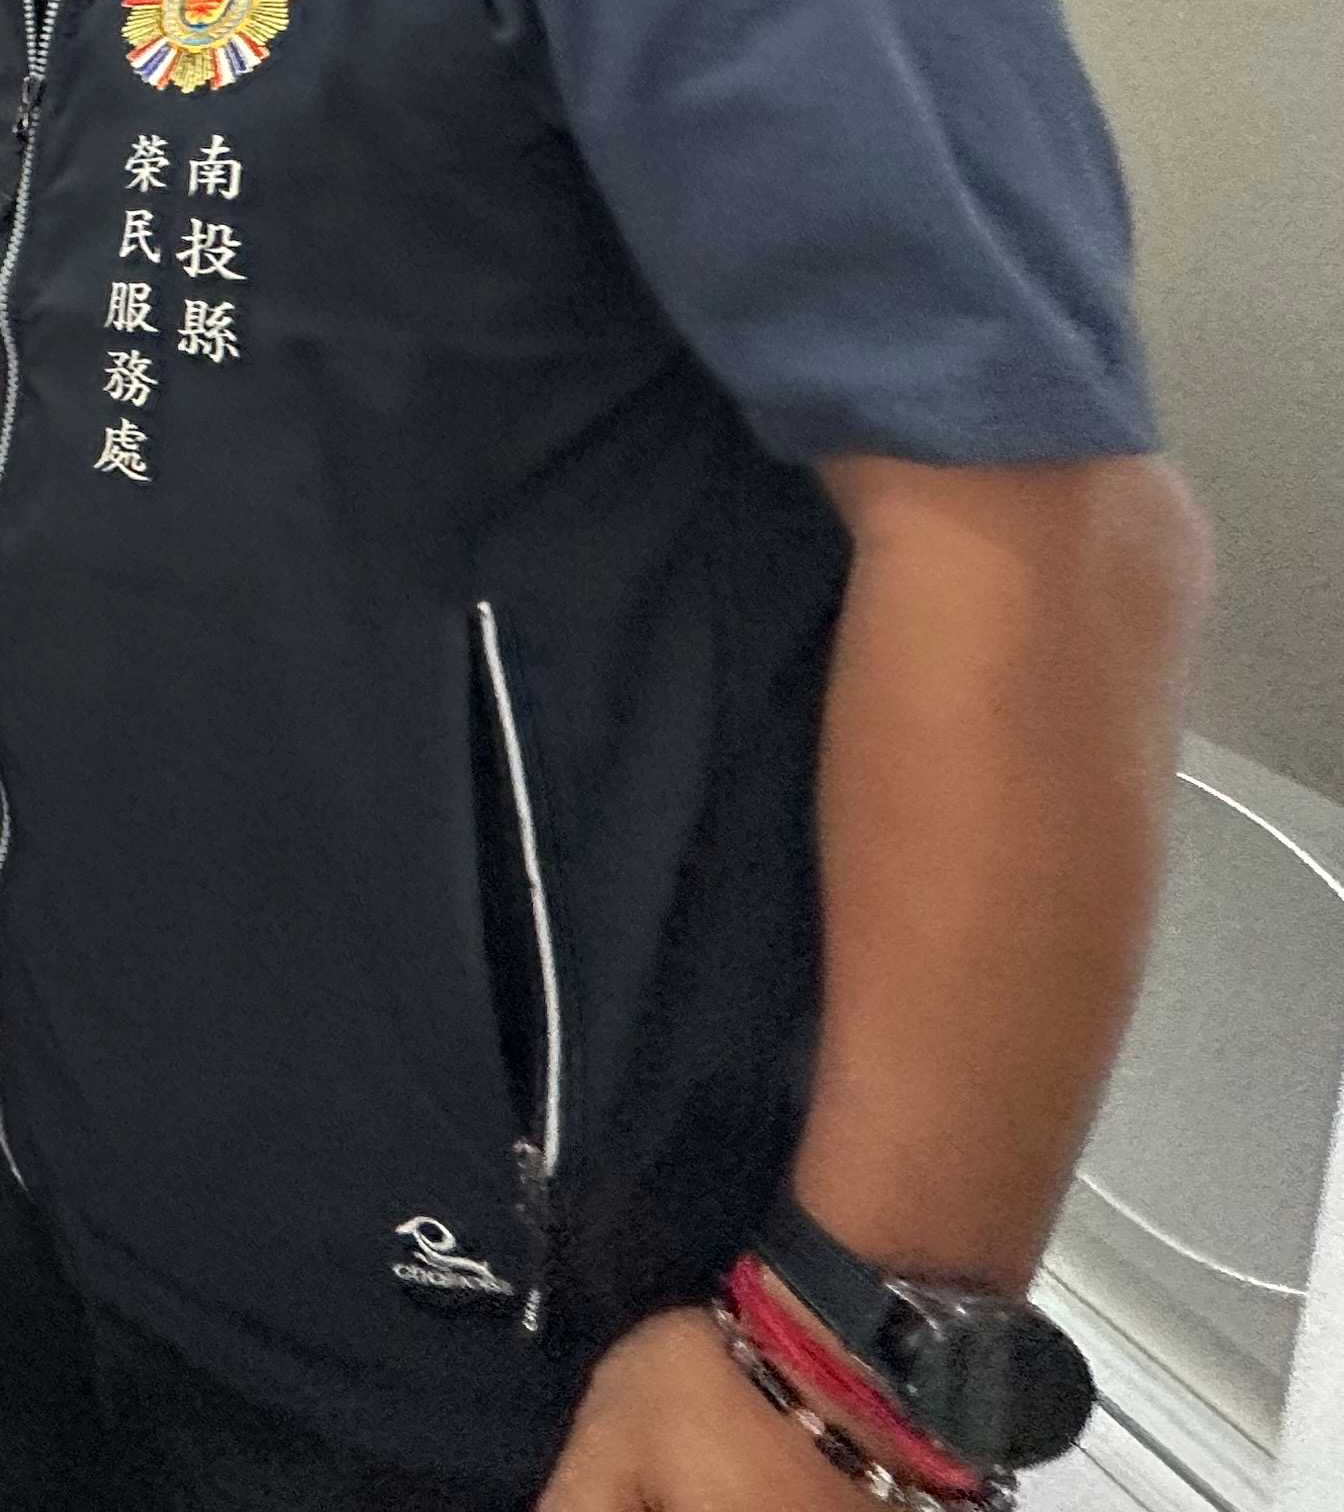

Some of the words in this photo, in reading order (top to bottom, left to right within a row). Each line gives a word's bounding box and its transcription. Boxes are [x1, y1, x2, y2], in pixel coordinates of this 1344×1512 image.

[93, 134, 170, 483] 榮民服務處
[177, 134, 248, 364] 南投縣
